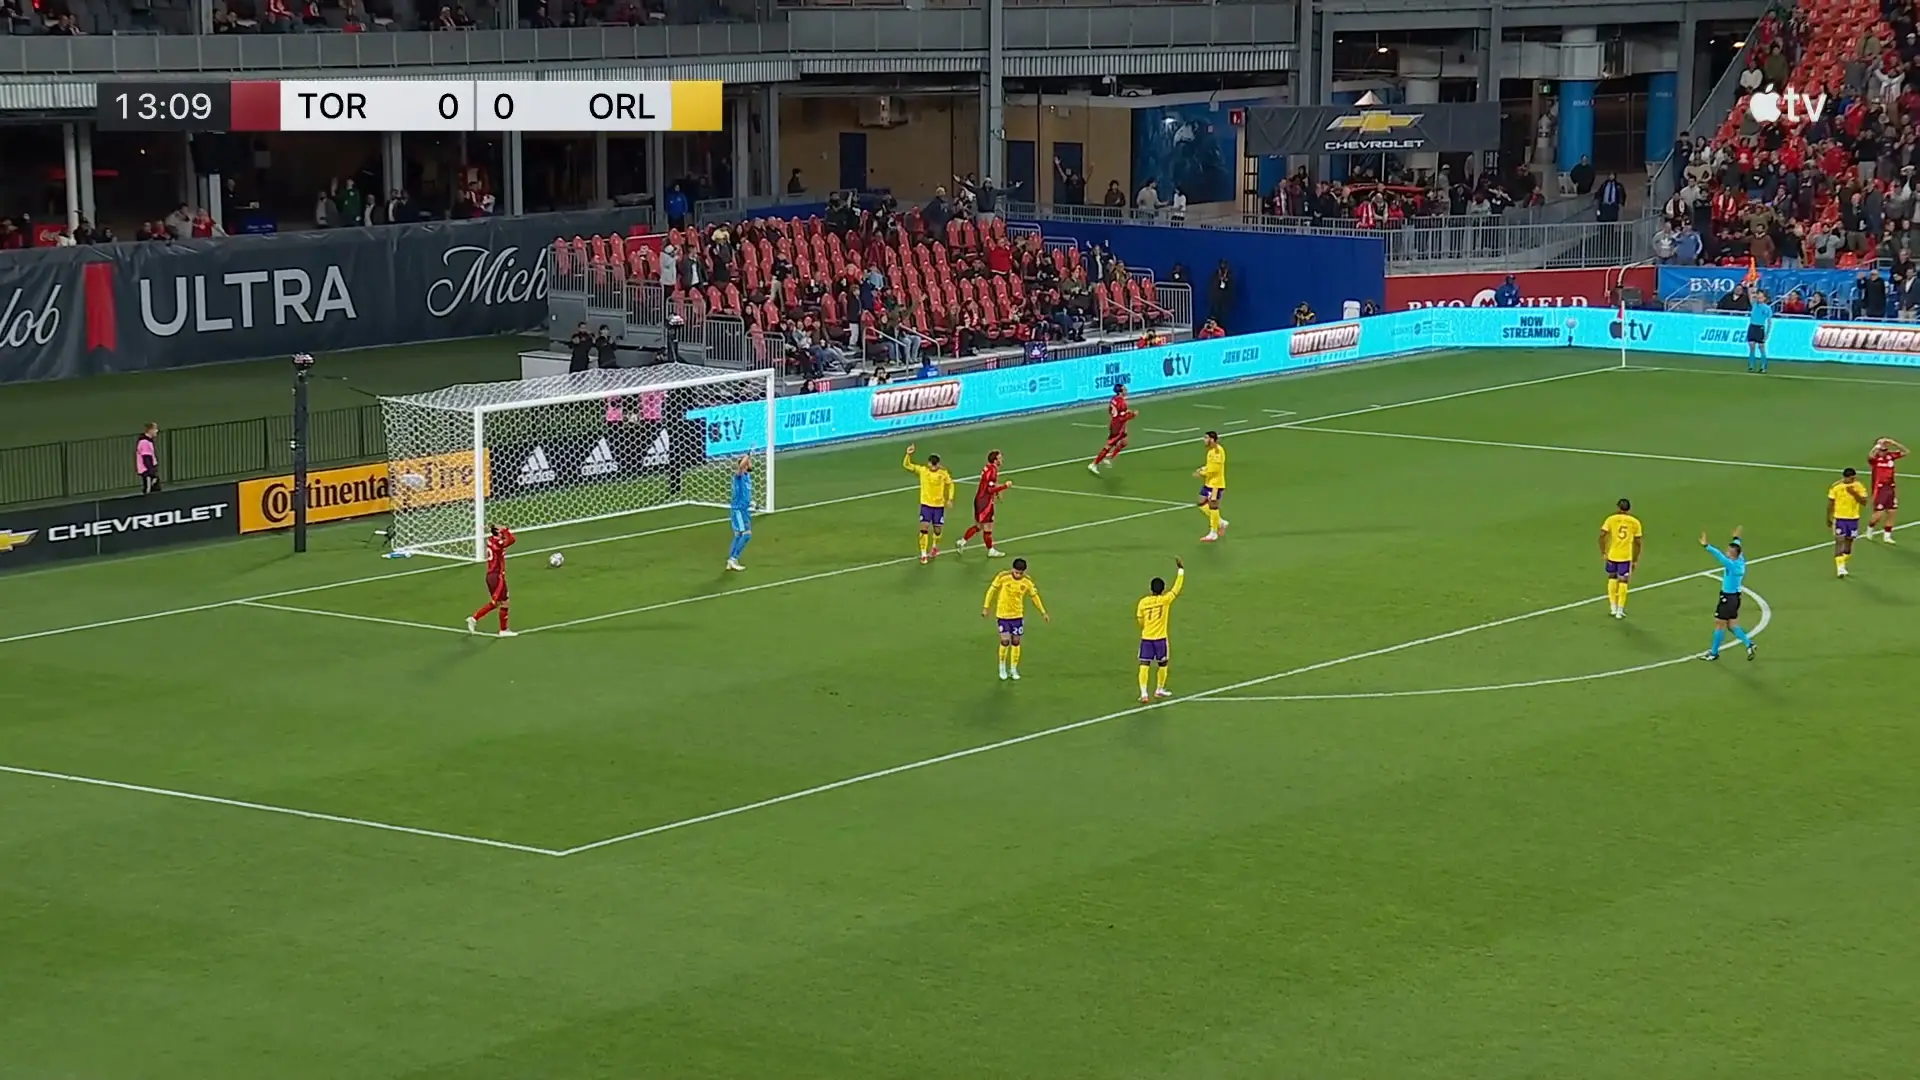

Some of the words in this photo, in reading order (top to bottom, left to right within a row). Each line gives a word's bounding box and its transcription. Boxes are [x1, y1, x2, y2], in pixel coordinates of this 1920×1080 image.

[1325, 140, 1424, 150] CHEVROLET
[1690, 278, 1735, 293] BMO
[139, 265, 357, 337] ULTRA
[1520, 316, 1544, 327] NOW
[1502, 327, 1560, 339] STREAMING
[1628, 319, 1653, 341] tv
[1701, 328, 1728, 342] JOHN
[1290, 326, 1360, 353] MATCHBOX
[1105, 362, 1120, 375] NOW
[1175, 353, 1191, 375] tv
[1095, 373, 1131, 389] STREAMING
[872, 383, 960, 415] MATCHBOX
[784, 411, 806, 428] JOHN
[809, 408, 831, 425] CENA
[48, 503, 228, 541] CHEVROLET
[1617, 525, 1628, 540] 5
[1012, 626, 1024, 635] 20
